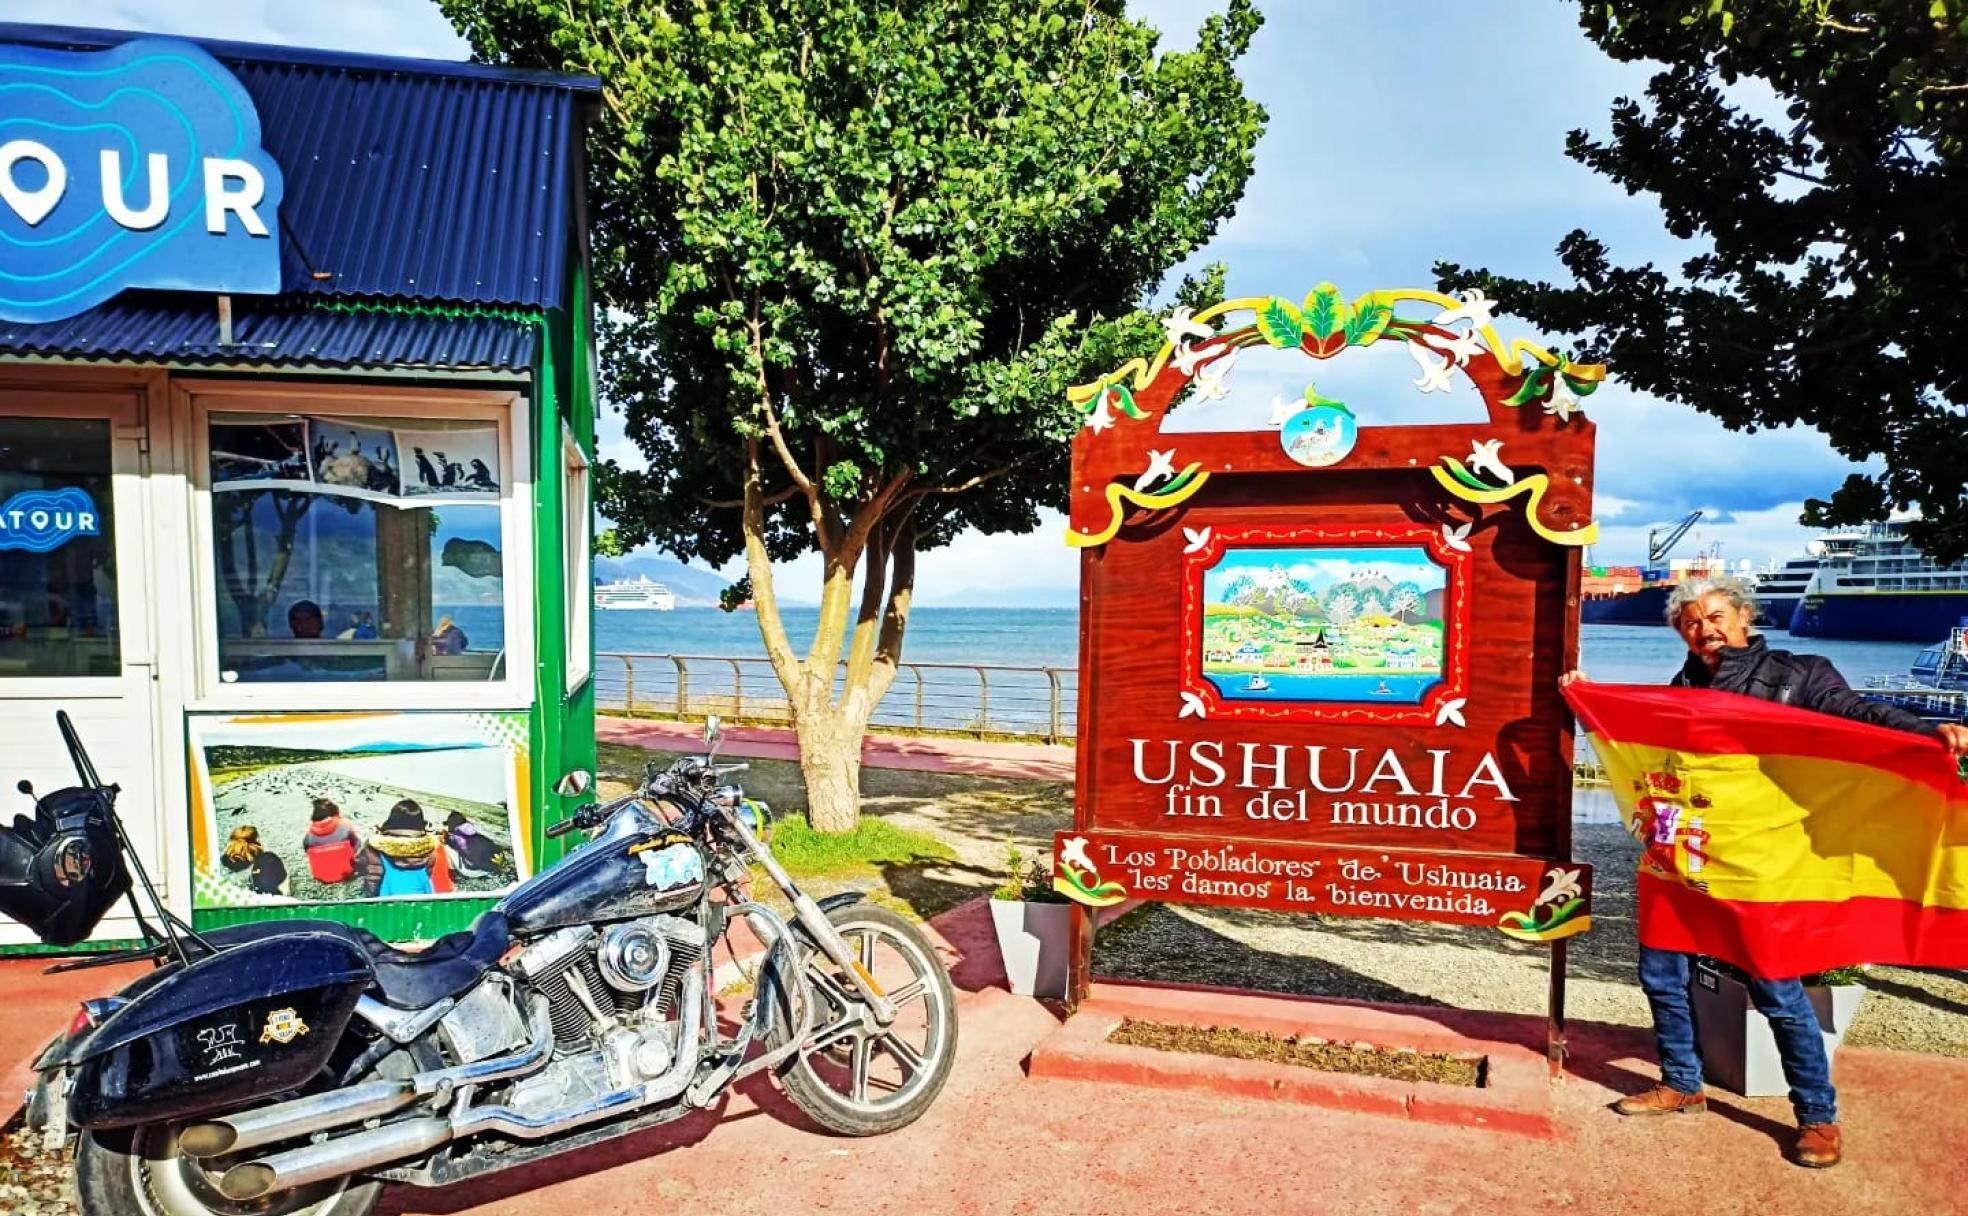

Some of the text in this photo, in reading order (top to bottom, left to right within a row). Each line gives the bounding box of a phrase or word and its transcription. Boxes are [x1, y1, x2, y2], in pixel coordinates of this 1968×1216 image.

[1127, 738, 1521, 802] USHUAIA
[1165, 784, 1477, 830] fin del mundo
[1101, 845, 1526, 892] Los Pobladores de Ushuaia
[1128, 868, 1496, 917] les damos la bienvenida
